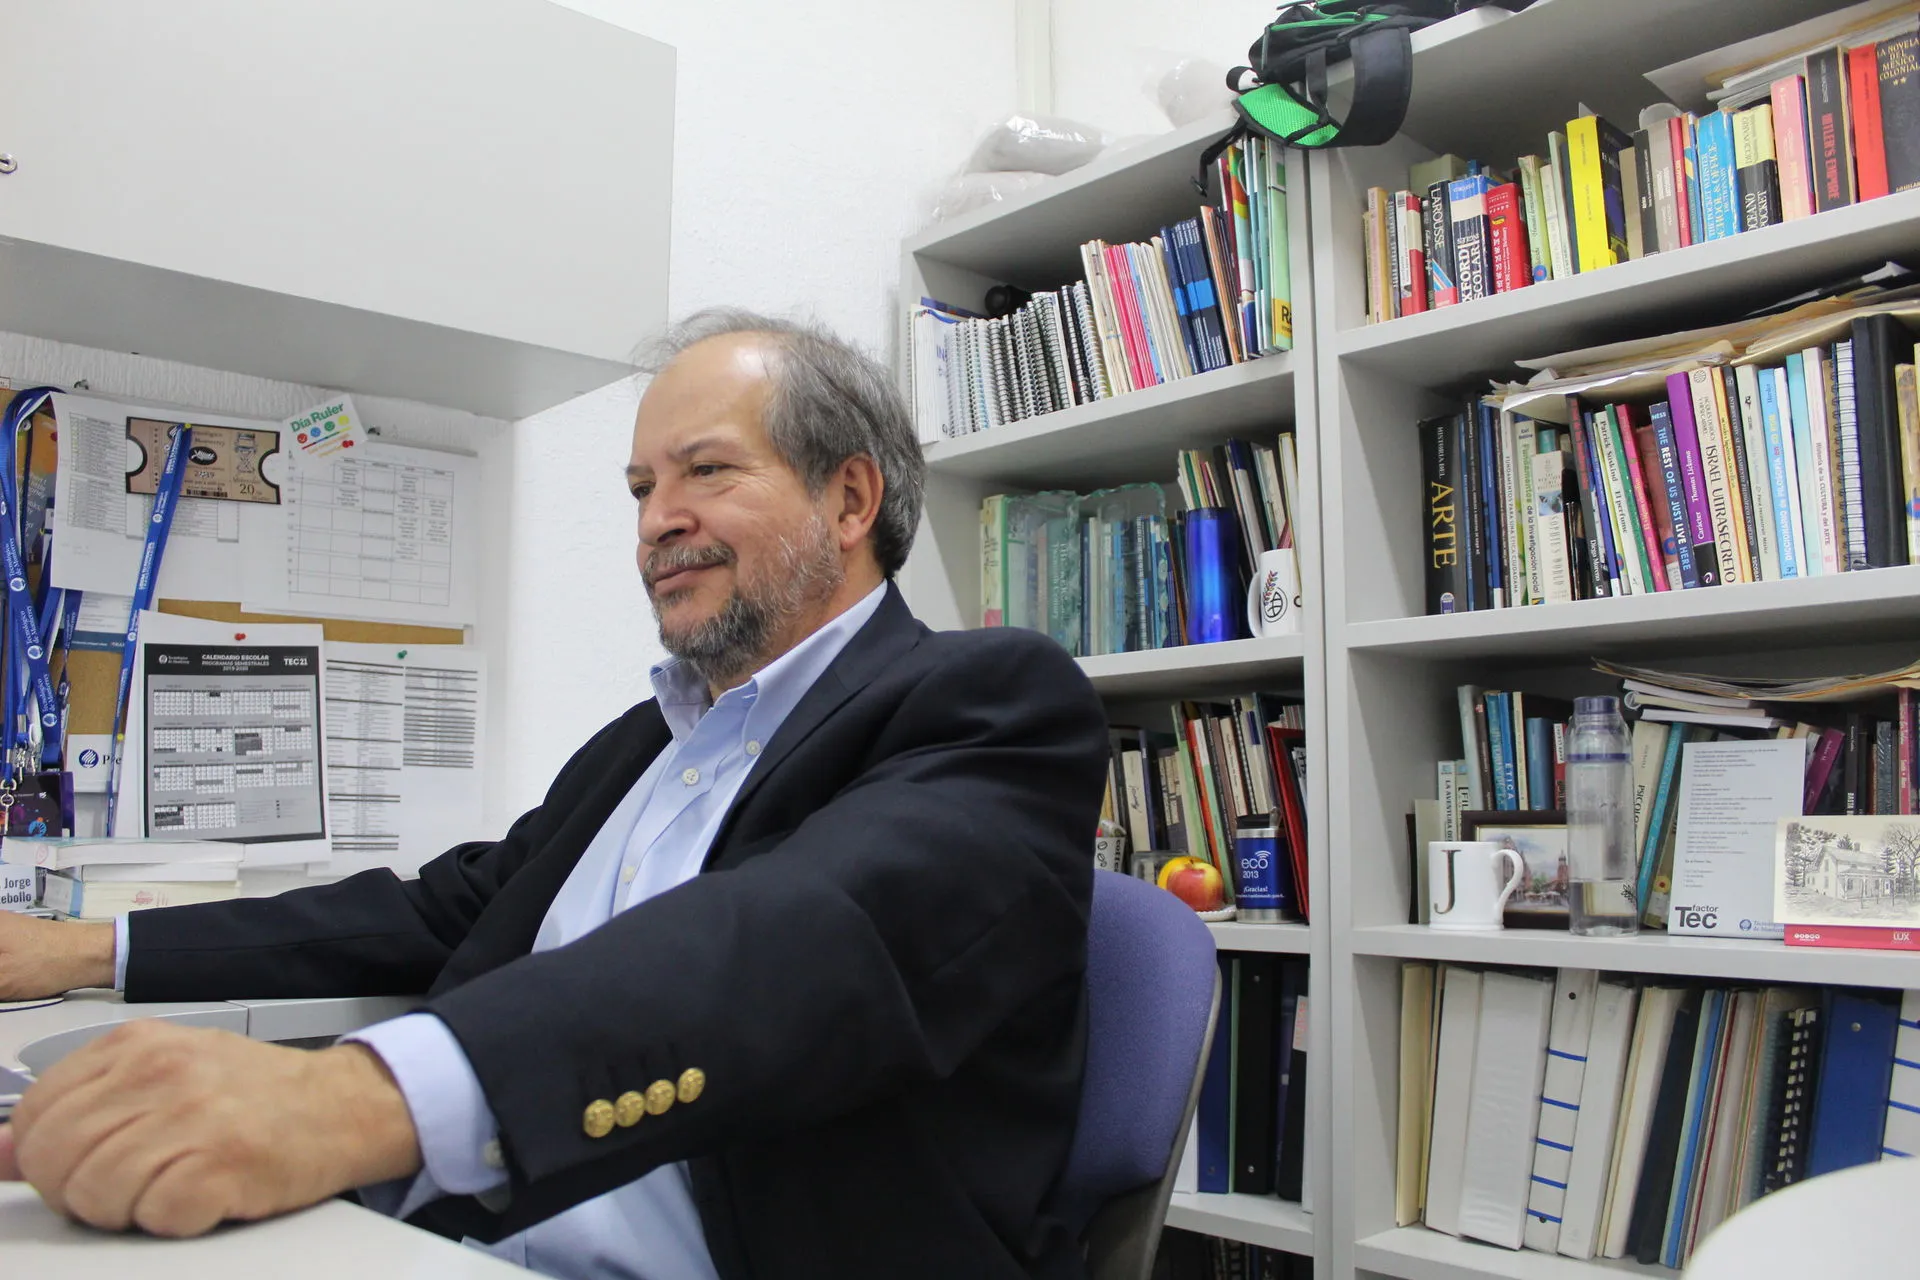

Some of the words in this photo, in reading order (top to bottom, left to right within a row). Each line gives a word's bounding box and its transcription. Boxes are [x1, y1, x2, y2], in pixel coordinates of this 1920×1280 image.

[1888, 37, 1919, 51] NOVELA
[1890, 50, 1906, 60] DEL
[1702, 153, 1711, 190] WEBSTER
[1708, 142, 1720, 183] OFFICE
[1826, 158, 1840, 201] EMPIRE
[1431, 187, 1445, 250] LAROUSSE
[1458, 248, 1473, 302] XFORD
[1470, 242, 1484, 300] SCOLAR
[310, 402, 344, 424] Ruler
[1651, 411, 1666, 420] NESS
[1658, 427, 1668, 444] THE
[1660, 446, 1672, 469] REST
[1706, 445, 1719, 486] ISRAEL
[1600, 420, 1609, 449] Patrick
[1616, 500, 1628, 534] perfume
[1665, 471, 1674, 484] OF
[1668, 486, 1678, 498] US
[1690, 477, 1698, 502] Thomas
[1522, 444, 1532, 503] Fundamentos
[1528, 524, 1538, 571] investigación
[1671, 501, 1682, 522] JUST
[1432, 481, 1458, 570] ARTE
[1675, 522, 1686, 544] LIVE
[1697, 512, 1705, 540] Carácter
[1712, 487, 1736, 584] ULTRASECRETO
[1778, 511, 1793, 562] DICCIONARIO
[1679, 546, 1691, 570] HERE
[1592, 559, 1600, 582] Moreno
[1445, 780, 1452, 790] LA
[1634, 784, 1646, 825] PSICOLO
[1241, 858, 1268, 870] eco
[1242, 870, 1258, 878] 2013
[4, 876, 31, 890] Jorge
[1434, 849, 1461, 915] J
[0, 890, 32, 904] ebollo
[1692, 904, 1719, 912] factor
[1675, 906, 1718, 928] Tec
